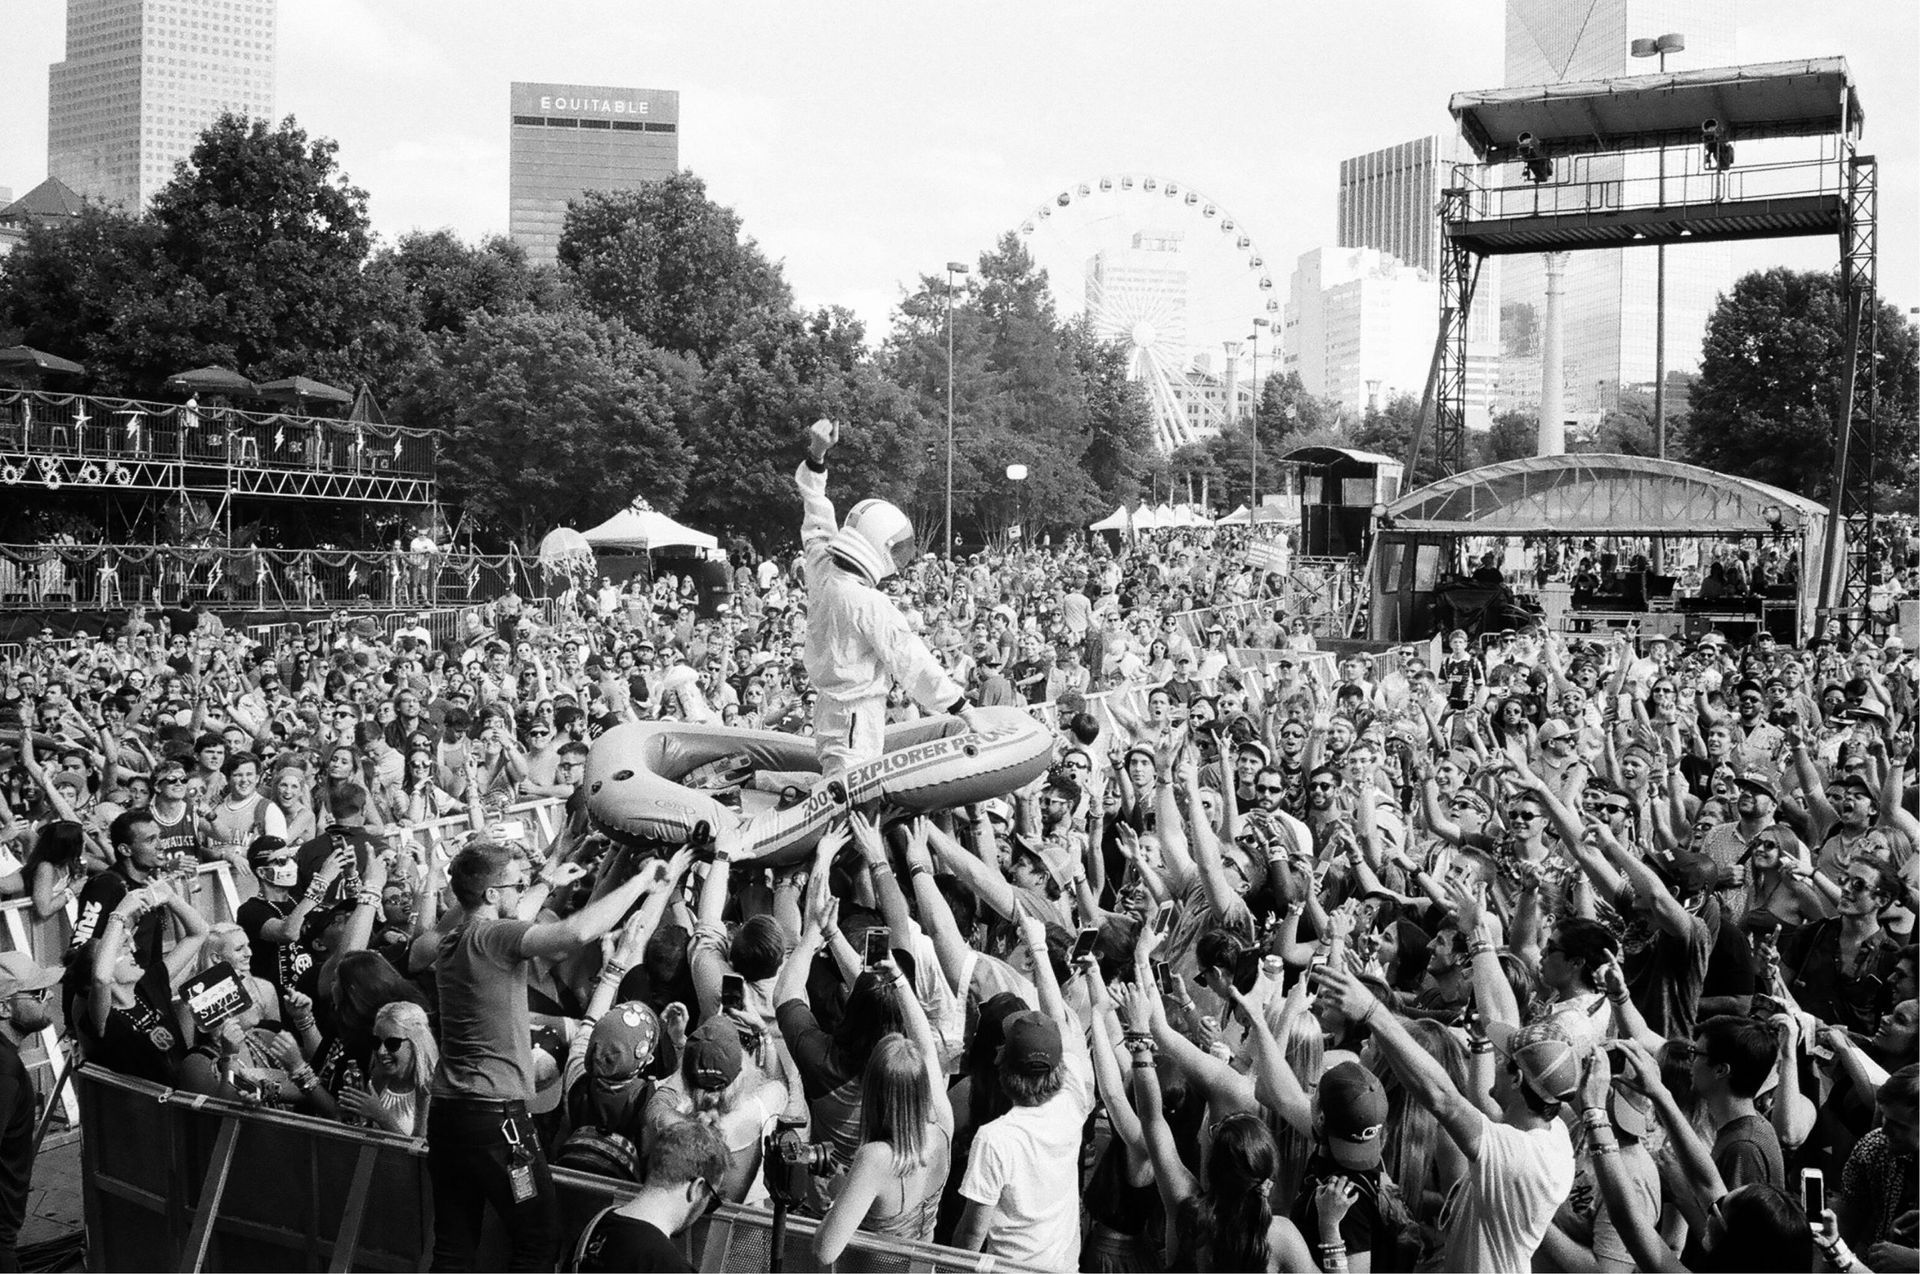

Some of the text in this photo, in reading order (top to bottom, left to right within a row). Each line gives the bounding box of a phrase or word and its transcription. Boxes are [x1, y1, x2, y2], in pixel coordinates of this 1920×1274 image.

[541, 96, 649, 114] EQUITABLE
[848, 742, 948, 788] EXPLORER
[200, 990, 241, 1019] STYLE
